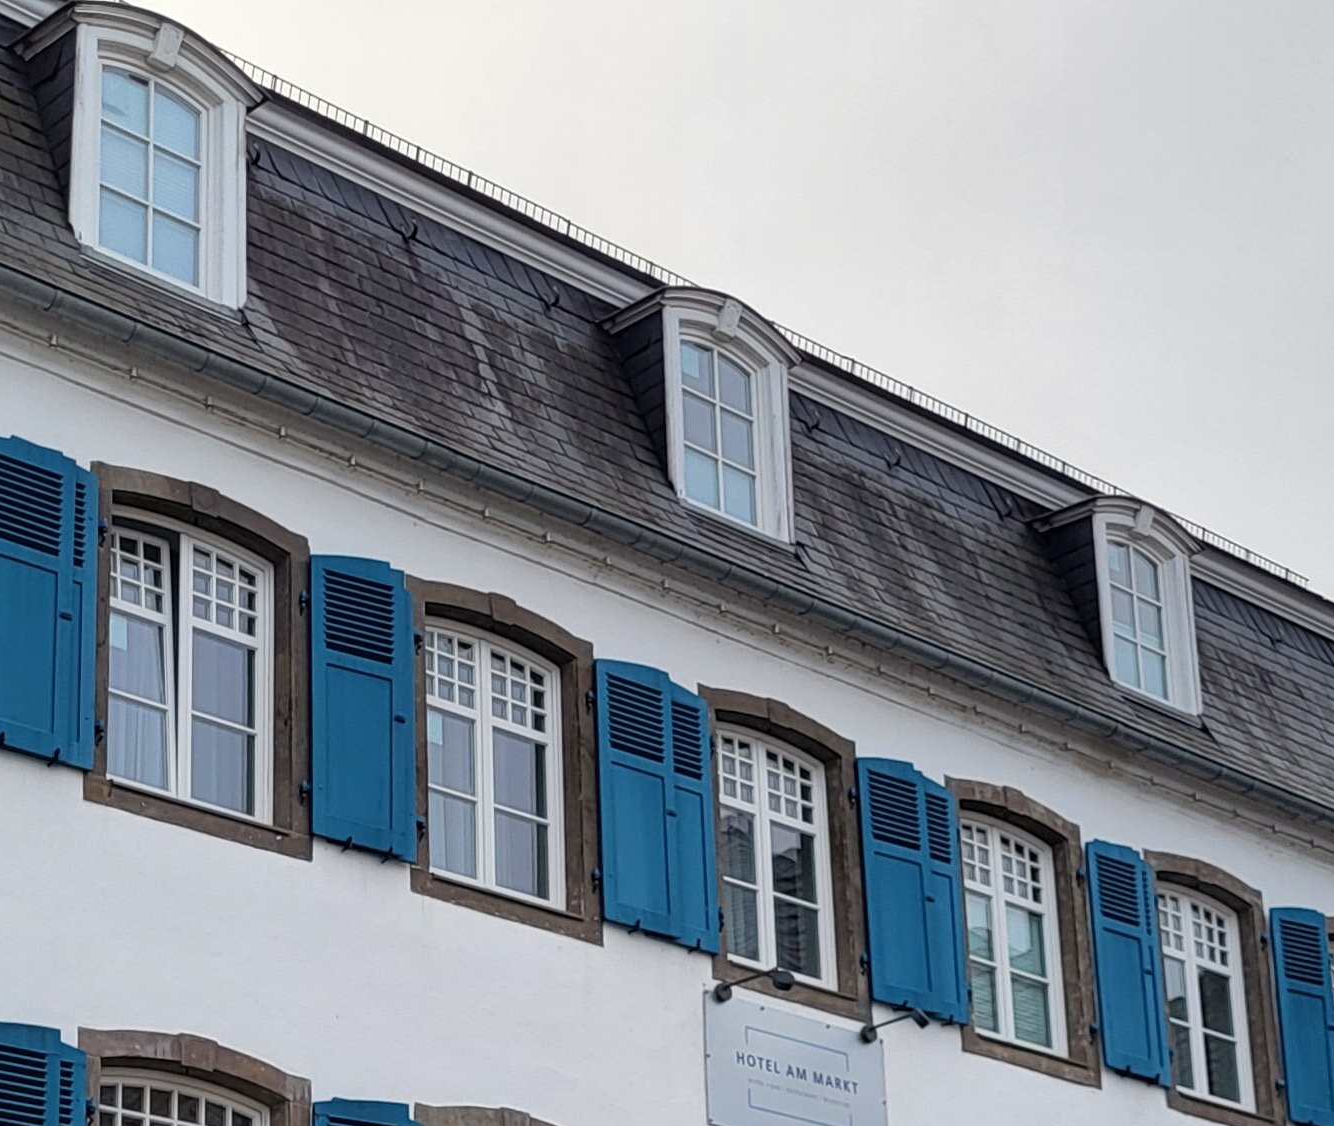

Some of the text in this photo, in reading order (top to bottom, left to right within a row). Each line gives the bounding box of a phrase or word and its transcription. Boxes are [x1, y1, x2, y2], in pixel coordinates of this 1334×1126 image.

[736, 1051, 780, 1075] HOTEL
[786, 1064, 807, 1081] AM
[813, 1071, 858, 1095] MARKT
